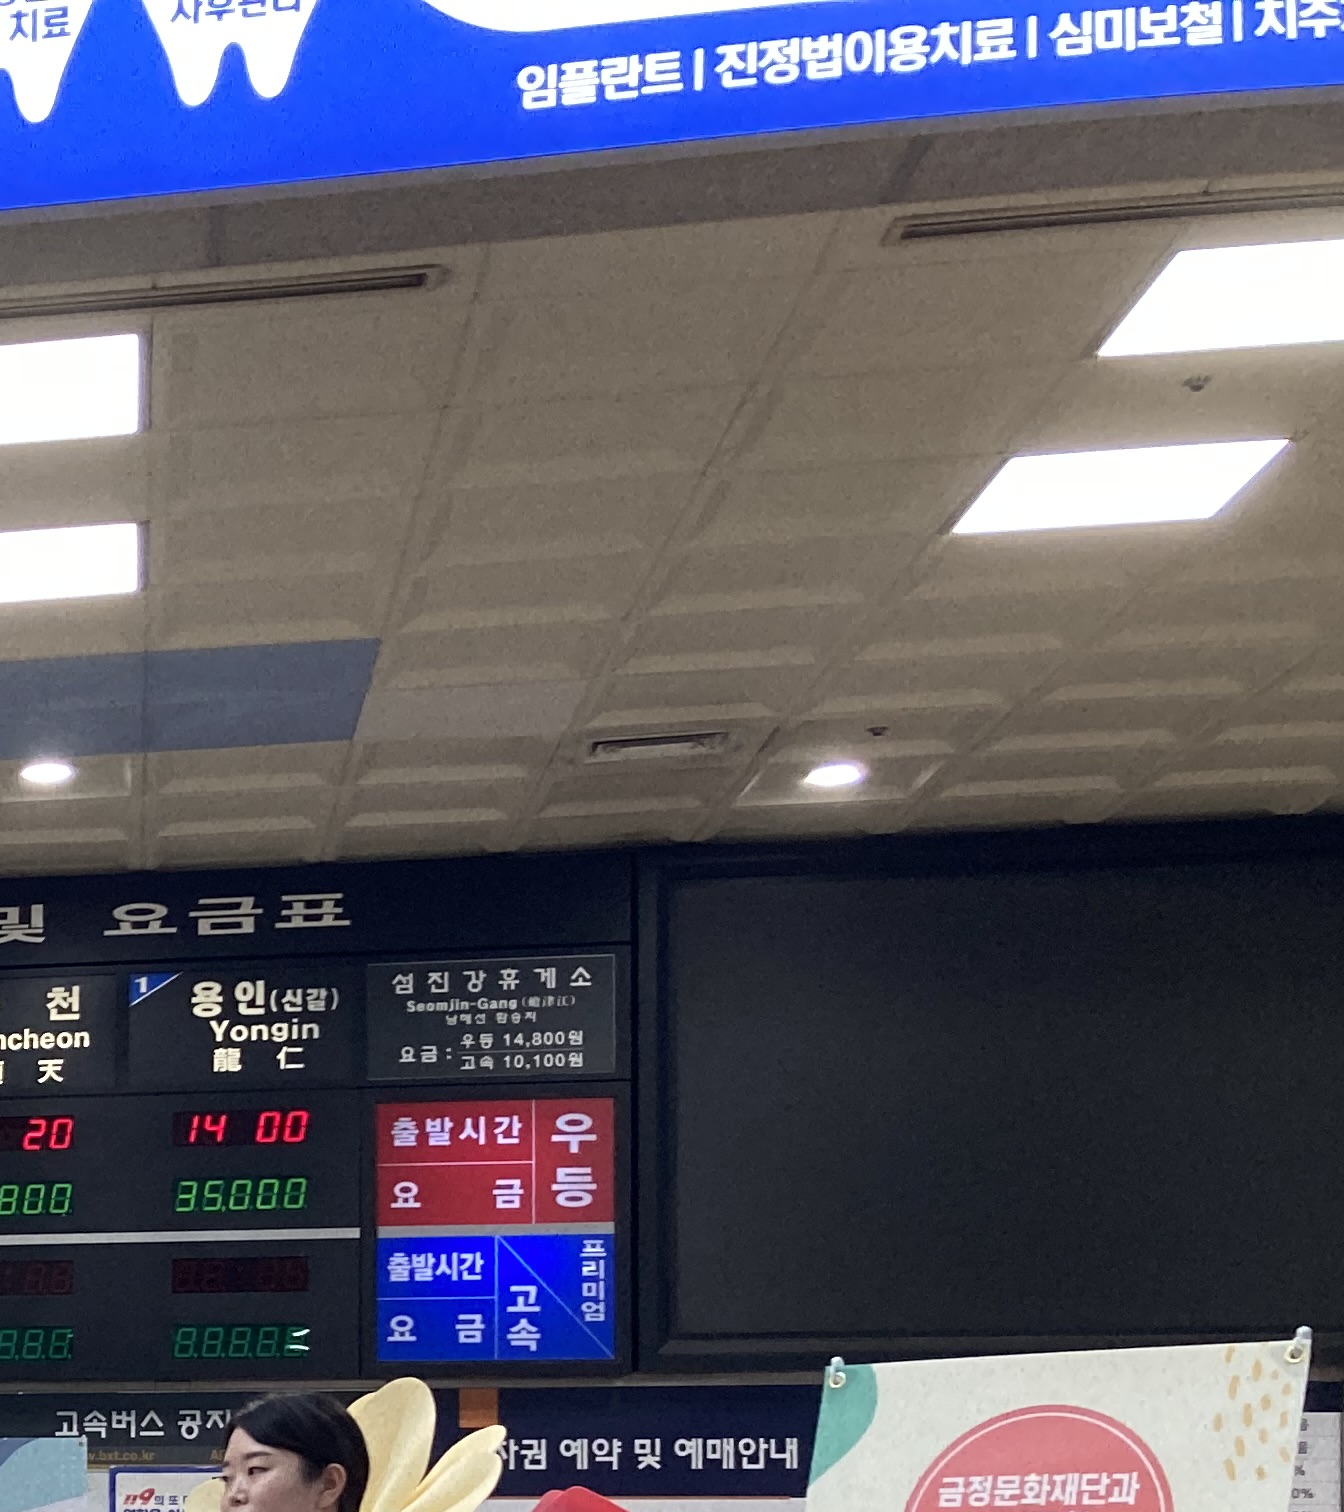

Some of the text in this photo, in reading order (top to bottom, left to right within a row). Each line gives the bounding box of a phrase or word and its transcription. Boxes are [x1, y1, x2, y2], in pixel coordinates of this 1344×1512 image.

[8, 4, 72, 43] 치료
[1050, 0, 1223, 59] 심미보철
[714, 16, 1017, 89] 진정법이용치료
[516, 49, 687, 111] 임플란트
[103, 892, 352, 938] 요금표
[134, 975, 149, 994] 1
[406, 996, 519, 1013] Seomjin-Gang
[210, 1018, 322, 1044] Yongin
[503, 1029, 585, 1049] 14,800원
[460, 1051, 585, 1071] 고속 10,100원
[21, 1118, 75, 1150] 20
[187, 1110, 310, 1144] 14 00
[389, 1114, 523, 1147] 출발시간
[386, 1250, 485, 1283] 출발시간
[54, 1409, 165, 1438] 고속버스
[558, 1436, 799, 1471] 예약 및 예매안내
[937, 1471, 1141, 1508] 금정문화재단과
